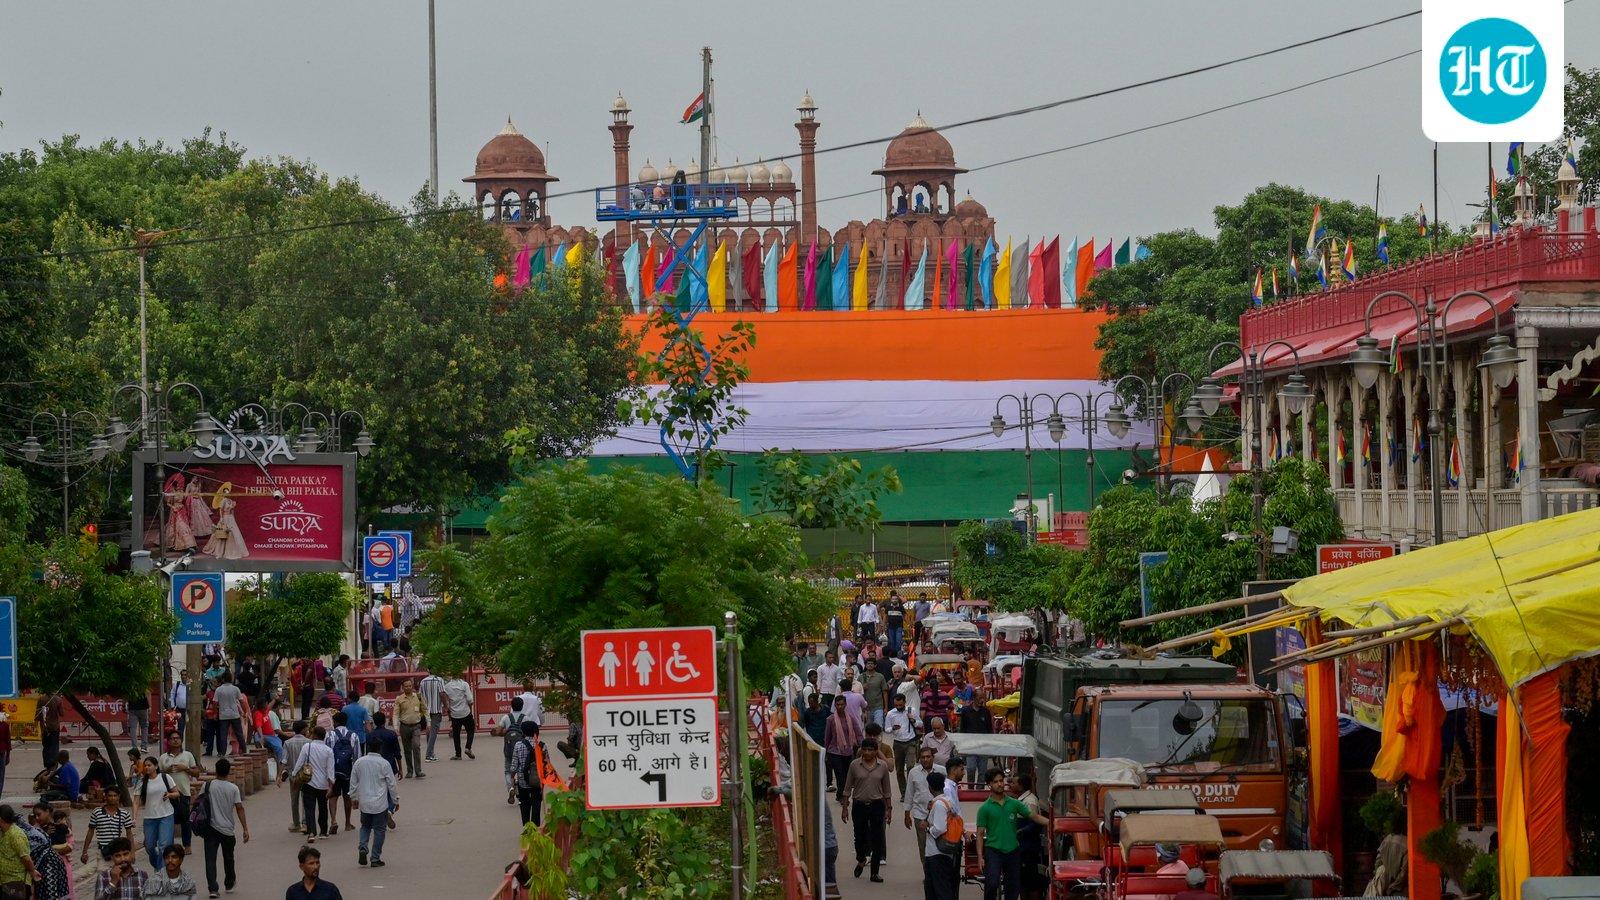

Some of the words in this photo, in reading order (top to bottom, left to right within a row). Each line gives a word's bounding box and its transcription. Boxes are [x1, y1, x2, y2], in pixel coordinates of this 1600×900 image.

[193, 435, 296, 466] SURYA
[290, 476, 327, 485] PAKKA?
[287, 487, 303, 496] BHI
[304, 487, 338, 496] PAKKA.
[260, 516, 322, 535] SURYA
[1356, 547, 1381, 559] वर्जित
[1321, 561, 1345, 569] Entry
[606, 708, 696, 727] TOILETS
[592, 734, 618, 748] जन
[626, 728, 670, 752] सुविधा
[679, 728, 711, 744] केन्द्र
[598, 759, 617, 772] 60
[621, 753, 642, 772] मी.
[651, 752, 681, 770] आगे
[1205, 784, 1240, 796] DUTY
